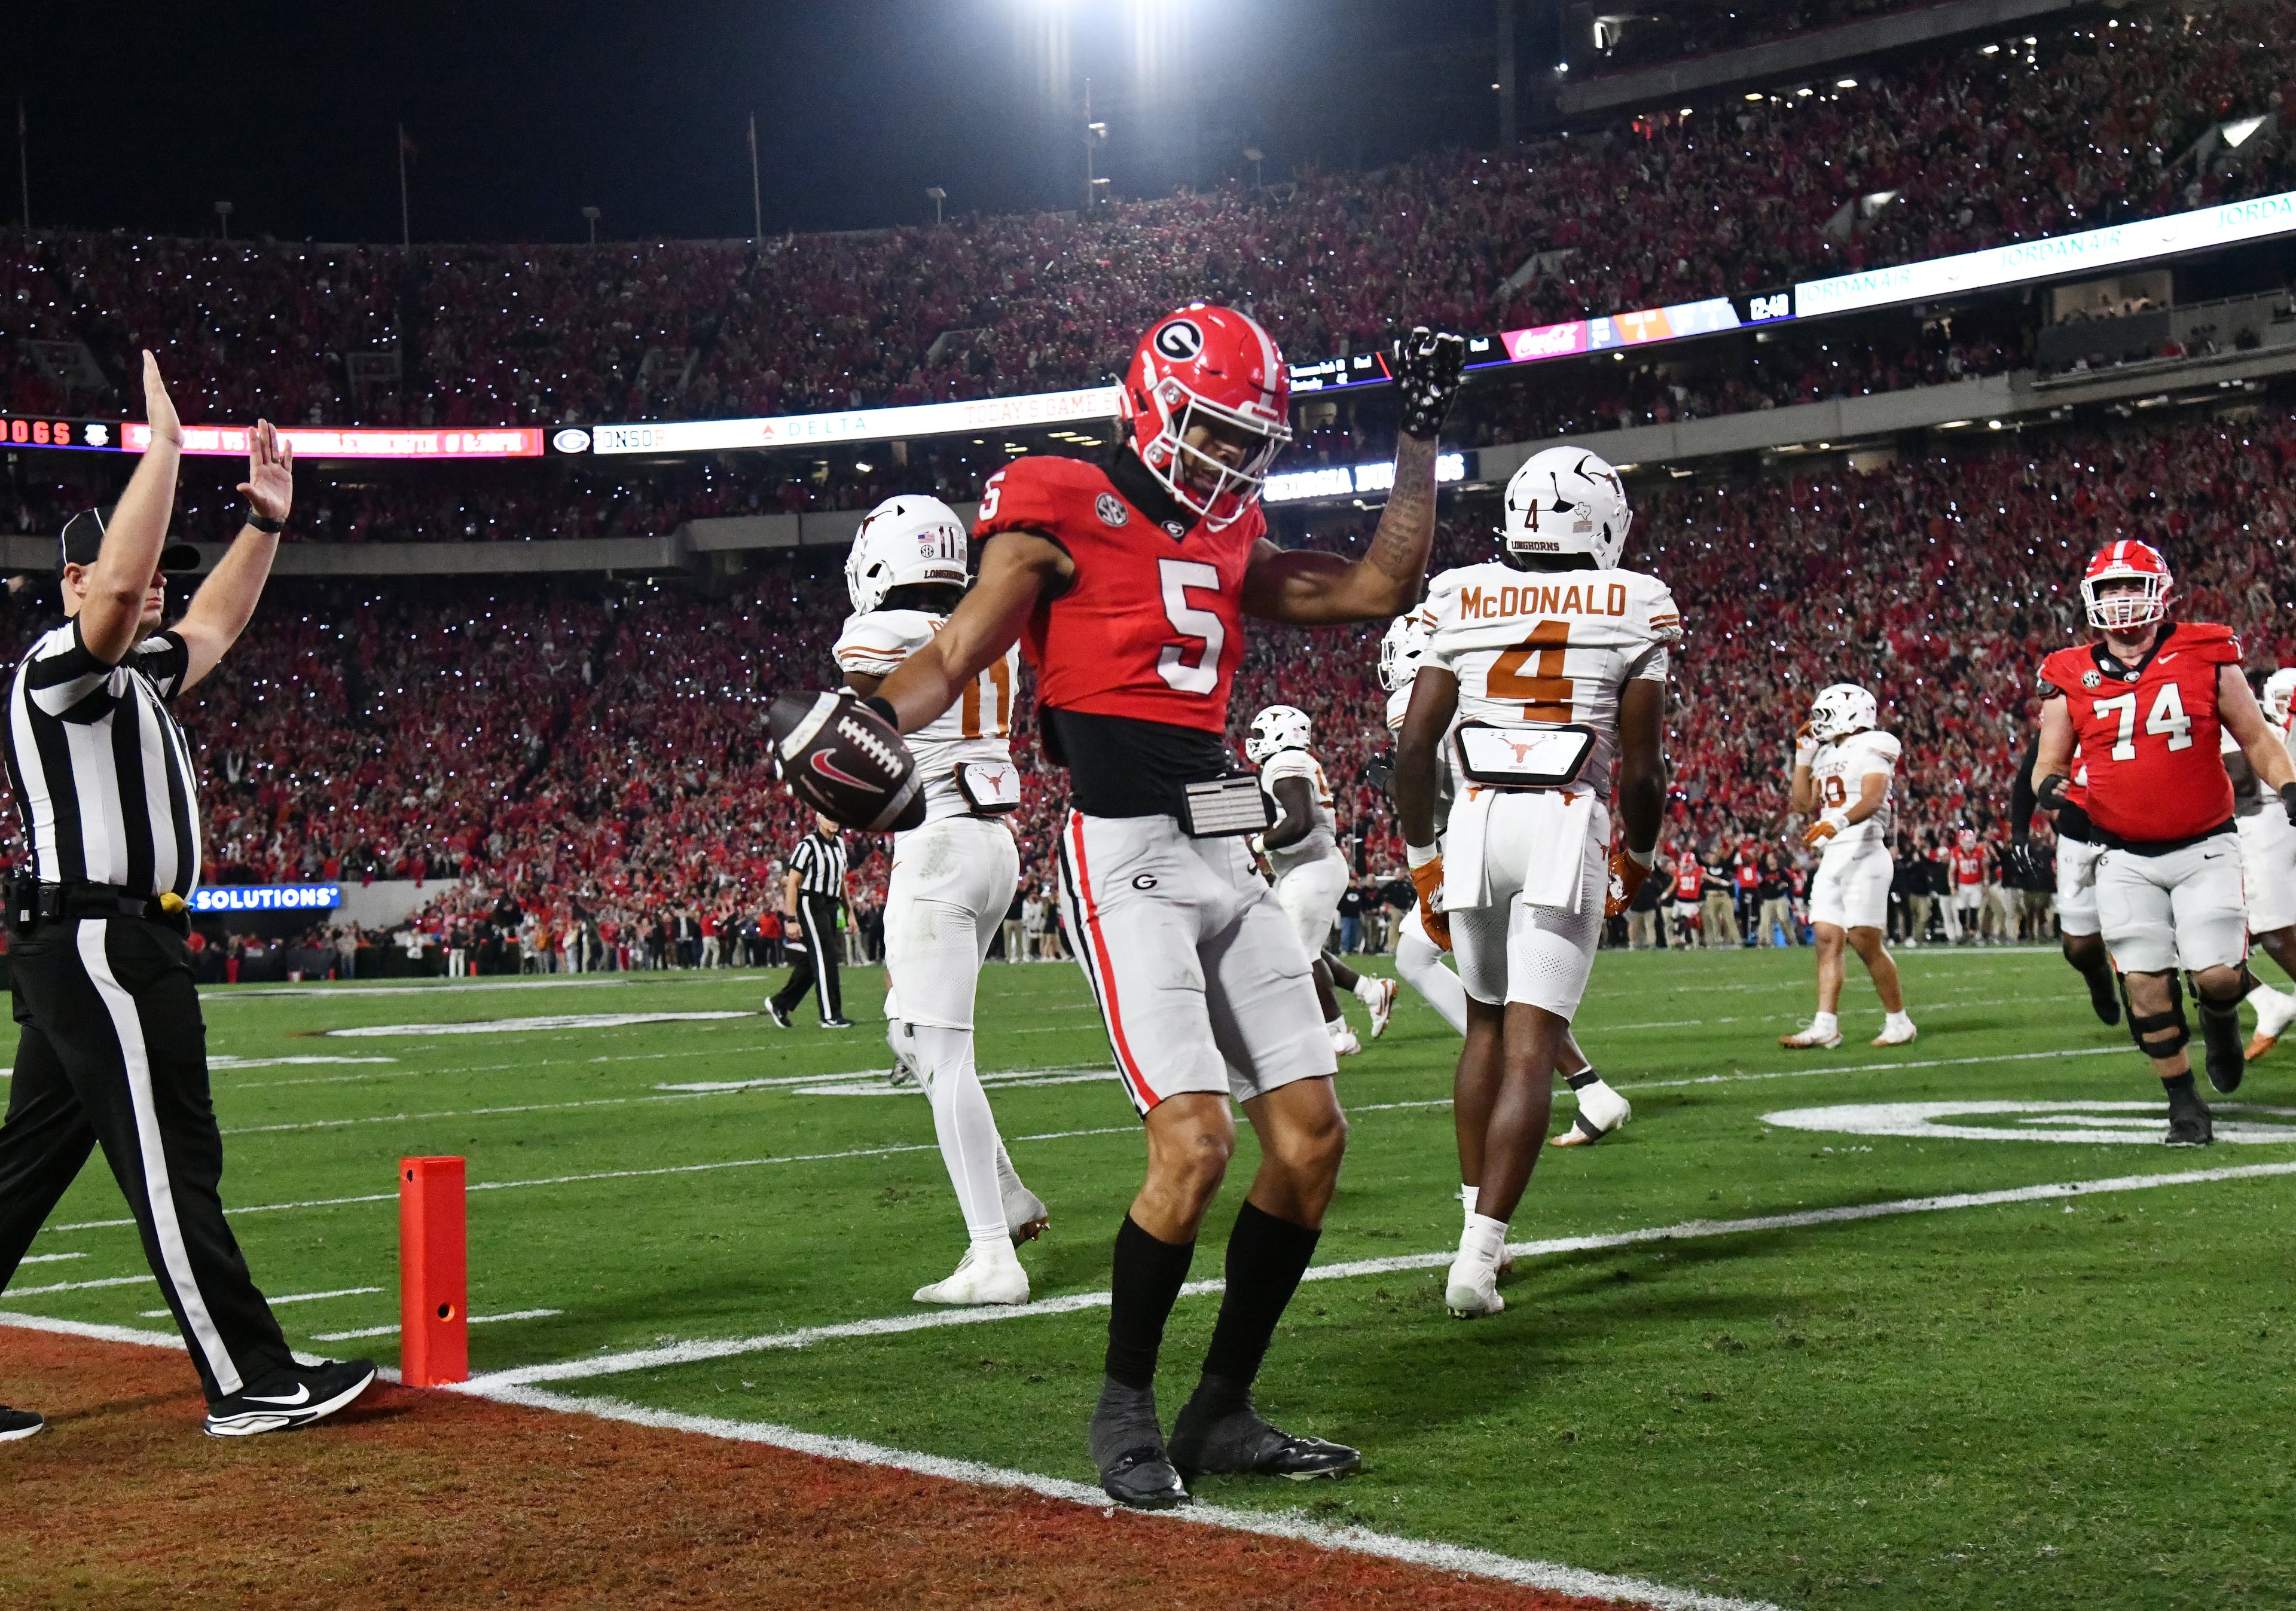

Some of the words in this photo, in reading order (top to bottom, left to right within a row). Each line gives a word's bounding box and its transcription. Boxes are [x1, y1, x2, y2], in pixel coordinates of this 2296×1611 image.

[964, 399, 1039, 424] TODAYS
[1046, 395, 1097, 417] GAME
[789, 417, 866, 436] DELTA
[978, 470, 1006, 521] 5
[1097, 494, 1126, 524] SEC
[1524, 499, 1539, 533] 4
[921, 545, 934, 558] SEC
[939, 526, 954, 558] 11
[1511, 540, 1560, 552] LONGHORNS
[924, 569, 966, 583] LONGHORNS
[1461, 583, 1627, 620] McDONALD
[1157, 558, 1225, 695] 5
[1485, 619, 1574, 724] 4
[2082, 670, 2101, 689] SEC
[2093, 682, 2194, 762] 74
[1132, 873, 1158, 890] G
